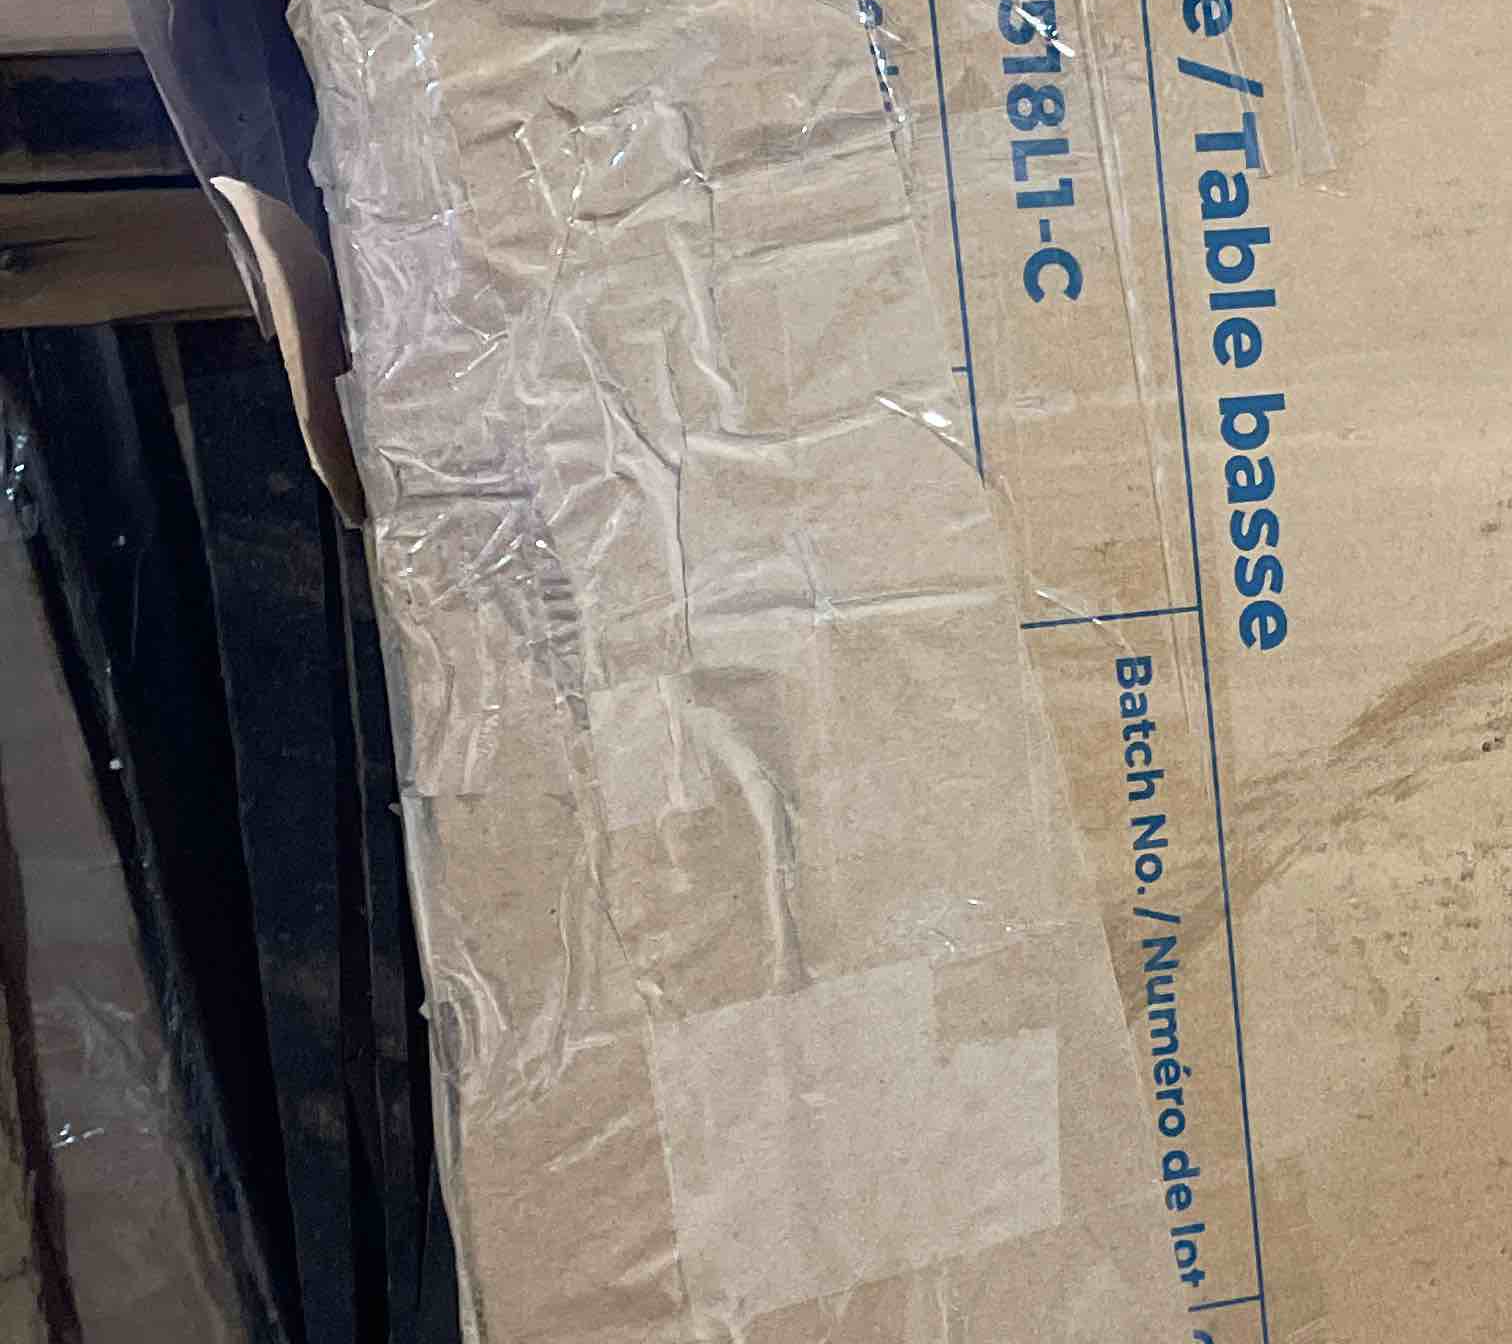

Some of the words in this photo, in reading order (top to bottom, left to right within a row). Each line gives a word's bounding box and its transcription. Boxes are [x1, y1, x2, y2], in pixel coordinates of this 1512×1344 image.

[1194, 111, 1277, 369] Table
[1218, 392, 1289, 652] basse
[1115, 655, 1167, 802] Batch
[1130, 813, 1169, 896] No.
[1140, 935, 1193, 1138] Numéro
[1162, 1149, 1201, 1212] de
[1170, 1222, 1206, 1288] lot
